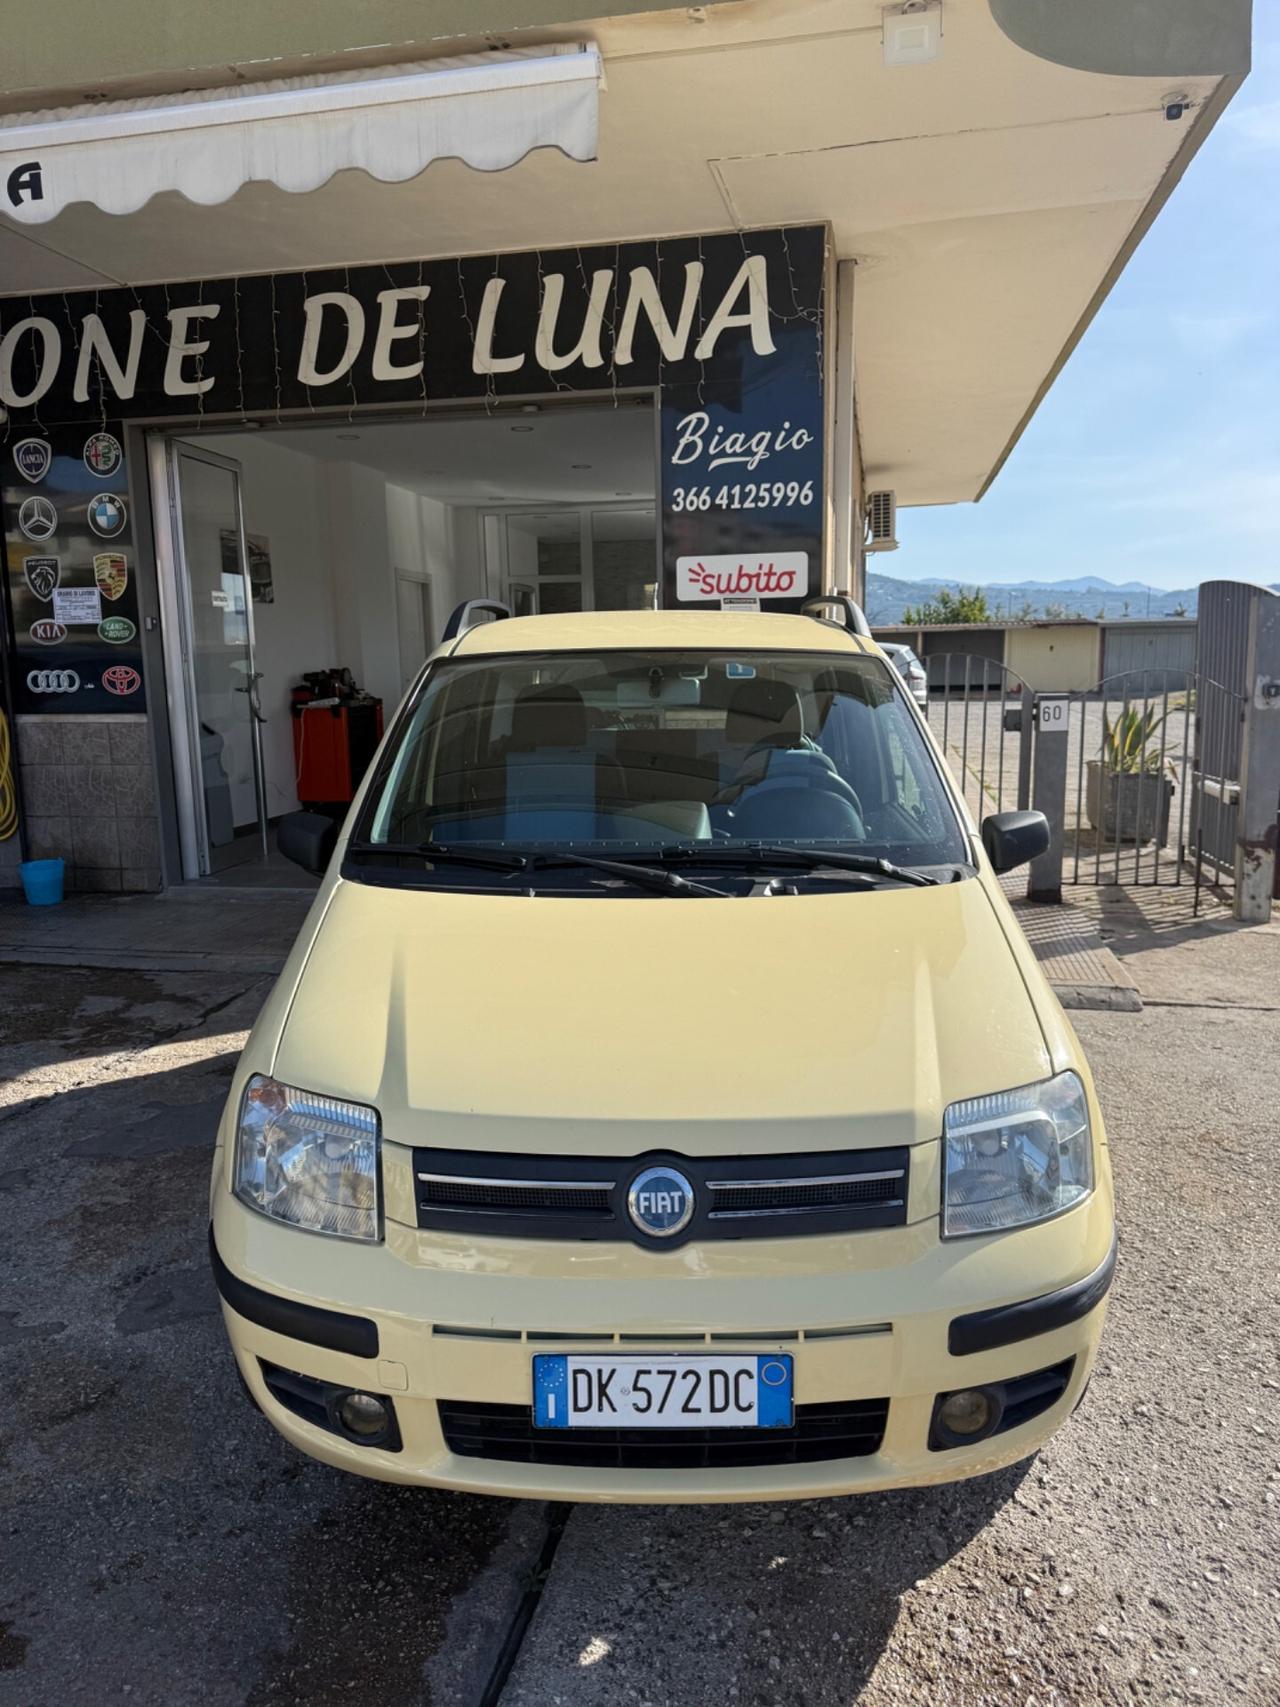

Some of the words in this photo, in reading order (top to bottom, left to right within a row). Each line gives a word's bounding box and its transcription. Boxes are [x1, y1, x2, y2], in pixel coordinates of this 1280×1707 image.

[7, 161, 44, 207] A
[0, 304, 221, 408] ONE
[297, 285, 431, 386] DE
[472, 255, 777, 374] LUNA
[671, 411, 814, 472] Biagio
[91, 495, 122, 509] BMW
[699, 562, 797, 595] subito
[36, 624, 61, 638] KIA
[1042, 705, 1062, 723] 60
[639, 1191, 683, 1214] FIAT
